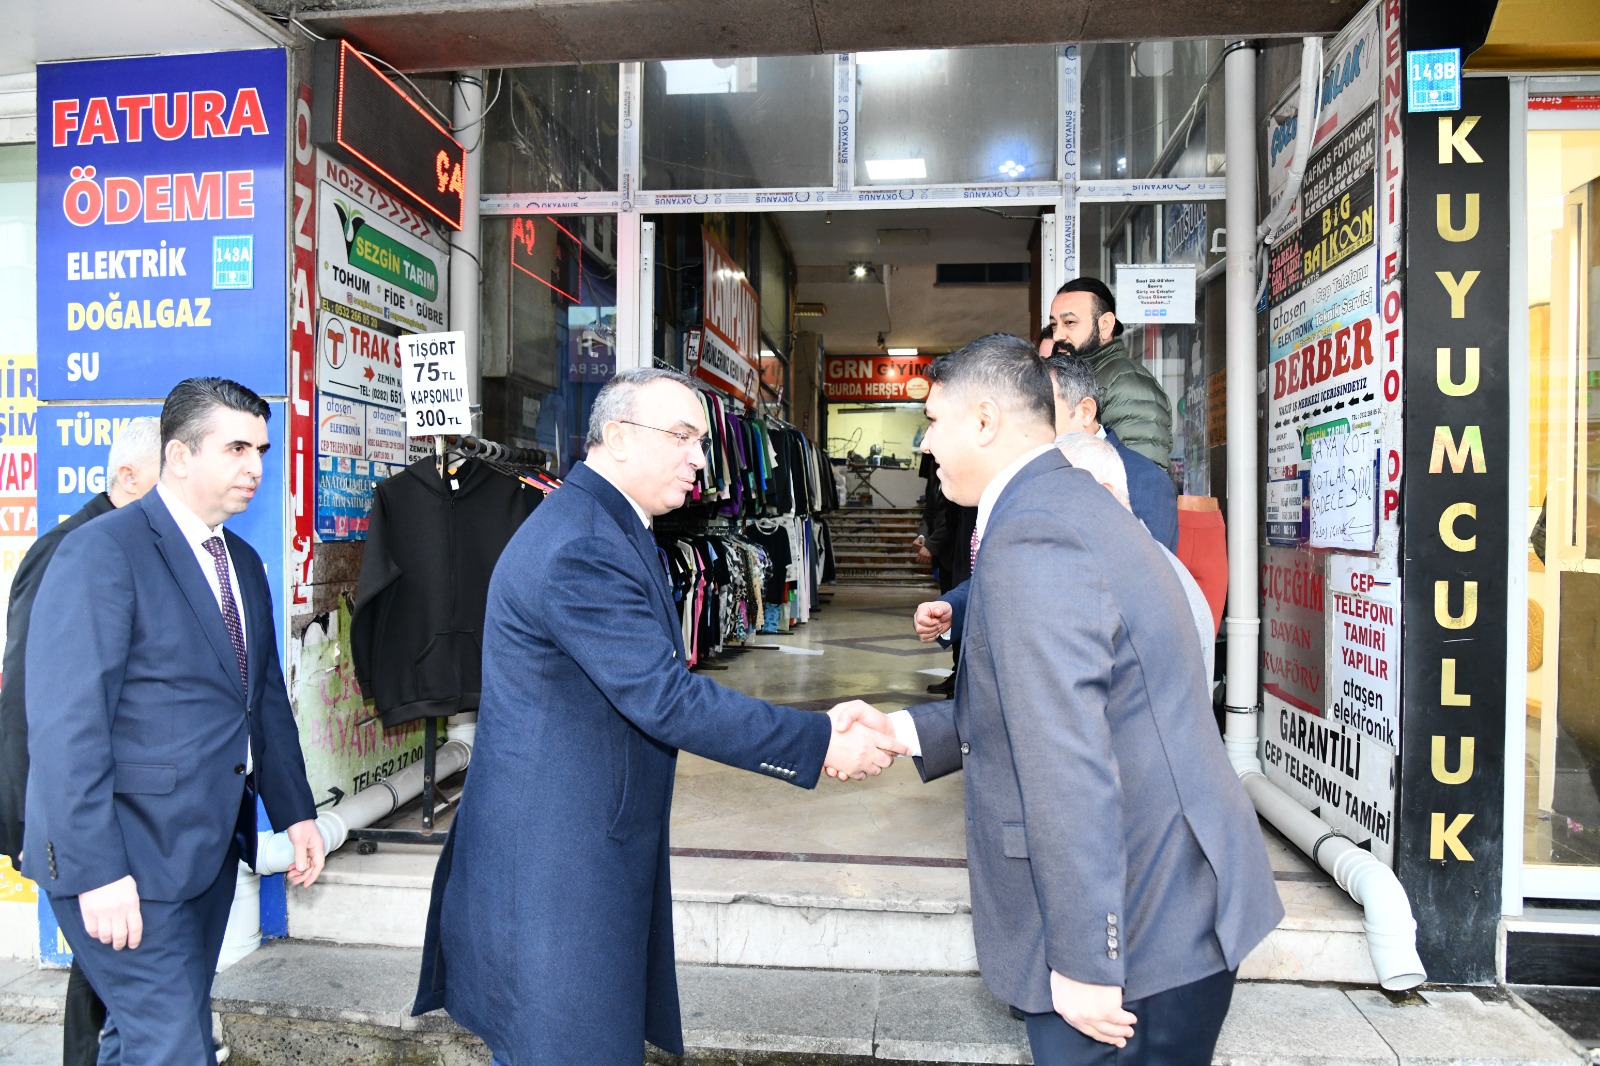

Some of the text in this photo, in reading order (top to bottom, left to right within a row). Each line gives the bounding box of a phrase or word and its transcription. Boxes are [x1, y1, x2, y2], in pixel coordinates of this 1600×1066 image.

[1412, 61, 1455, 82] 143B
[52, 87, 269, 148] FATURA
[1065, 110, 1073, 149] OKYANUS
[841, 125, 849, 164] OKYANUS
[1303, 108, 1376, 188] KAFKAS FOTOKOPİ
[1304, 139, 1374, 207] TABELA-BAYRAK
[62, 164, 255, 227] ÖDEME
[655, 197, 692, 205] OKYANUS
[755, 195, 794, 203] OKYANUS
[858, 194, 898, 202] OKYANUS
[963, 190, 1004, 199] OKYANUS
[1064, 215, 1072, 254] OKYANUS
[67, 239, 187, 281] ELEKTRİK
[216, 246, 250, 265] 143A
[356, 236, 436, 293] SEZGİN TARIM
[332, 265, 371, 296] TOHUM
[1316, 284, 1331, 303] Cep
[1332, 264, 1369, 294] Telefonu
[67, 292, 212, 332] DOĞALGAZ
[335, 303, 350, 319] 0532
[350, 308, 362, 323] 266
[384, 287, 406, 310] FİDE
[416, 301, 443, 326] GÜBRE
[1315, 302, 1341, 328] Teknik
[1341, 287, 1373, 315] Servisi
[350, 325, 390, 365] TRAK
[408, 338, 456, 360] TİŞÖRT
[1273, 317, 1374, 401] BERBER
[0, 359, 37, 400] İR
[67, 352, 99, 381] SU
[377, 373, 396, 387] ZEMİN
[413, 362, 456, 383] 75 TL
[828, 359, 873, 379] GRN
[360, 384, 402, 405] TEL: (0282) 651
[828, 383, 863, 396] BURDA
[865, 382, 905, 400] HERŞEY
[415, 408, 462, 428] 300 TL
[1343, 431, 1370, 457] KOT
[57, 466, 108, 494] DIG
[1429, 115, 1486, 862] KUYUMCULUK
[1311, 489, 1344, 520] SADECE
[1260, 556, 1324, 612] ÇİÇEĞİM
[1350, 572, 1375, 593] CEP
[1270, 618, 1311, 650] BAYAN
[1343, 622, 1386, 652] TAMİRİ
[1263, 651, 1321, 693] KVAFÖRÜ
[1341, 646, 1388, 681] YAPILIR
[1343, 677, 1384, 711] ataşen
[310, 708, 377, 758] BAYAN
[1333, 697, 1394, 747] elektronik
[1279, 708, 1361, 781] GARANTİLİ
[397, 752, 409, 772] 17
[1264, 739, 1391, 845] CEP TELEFONU TAMİRİ
